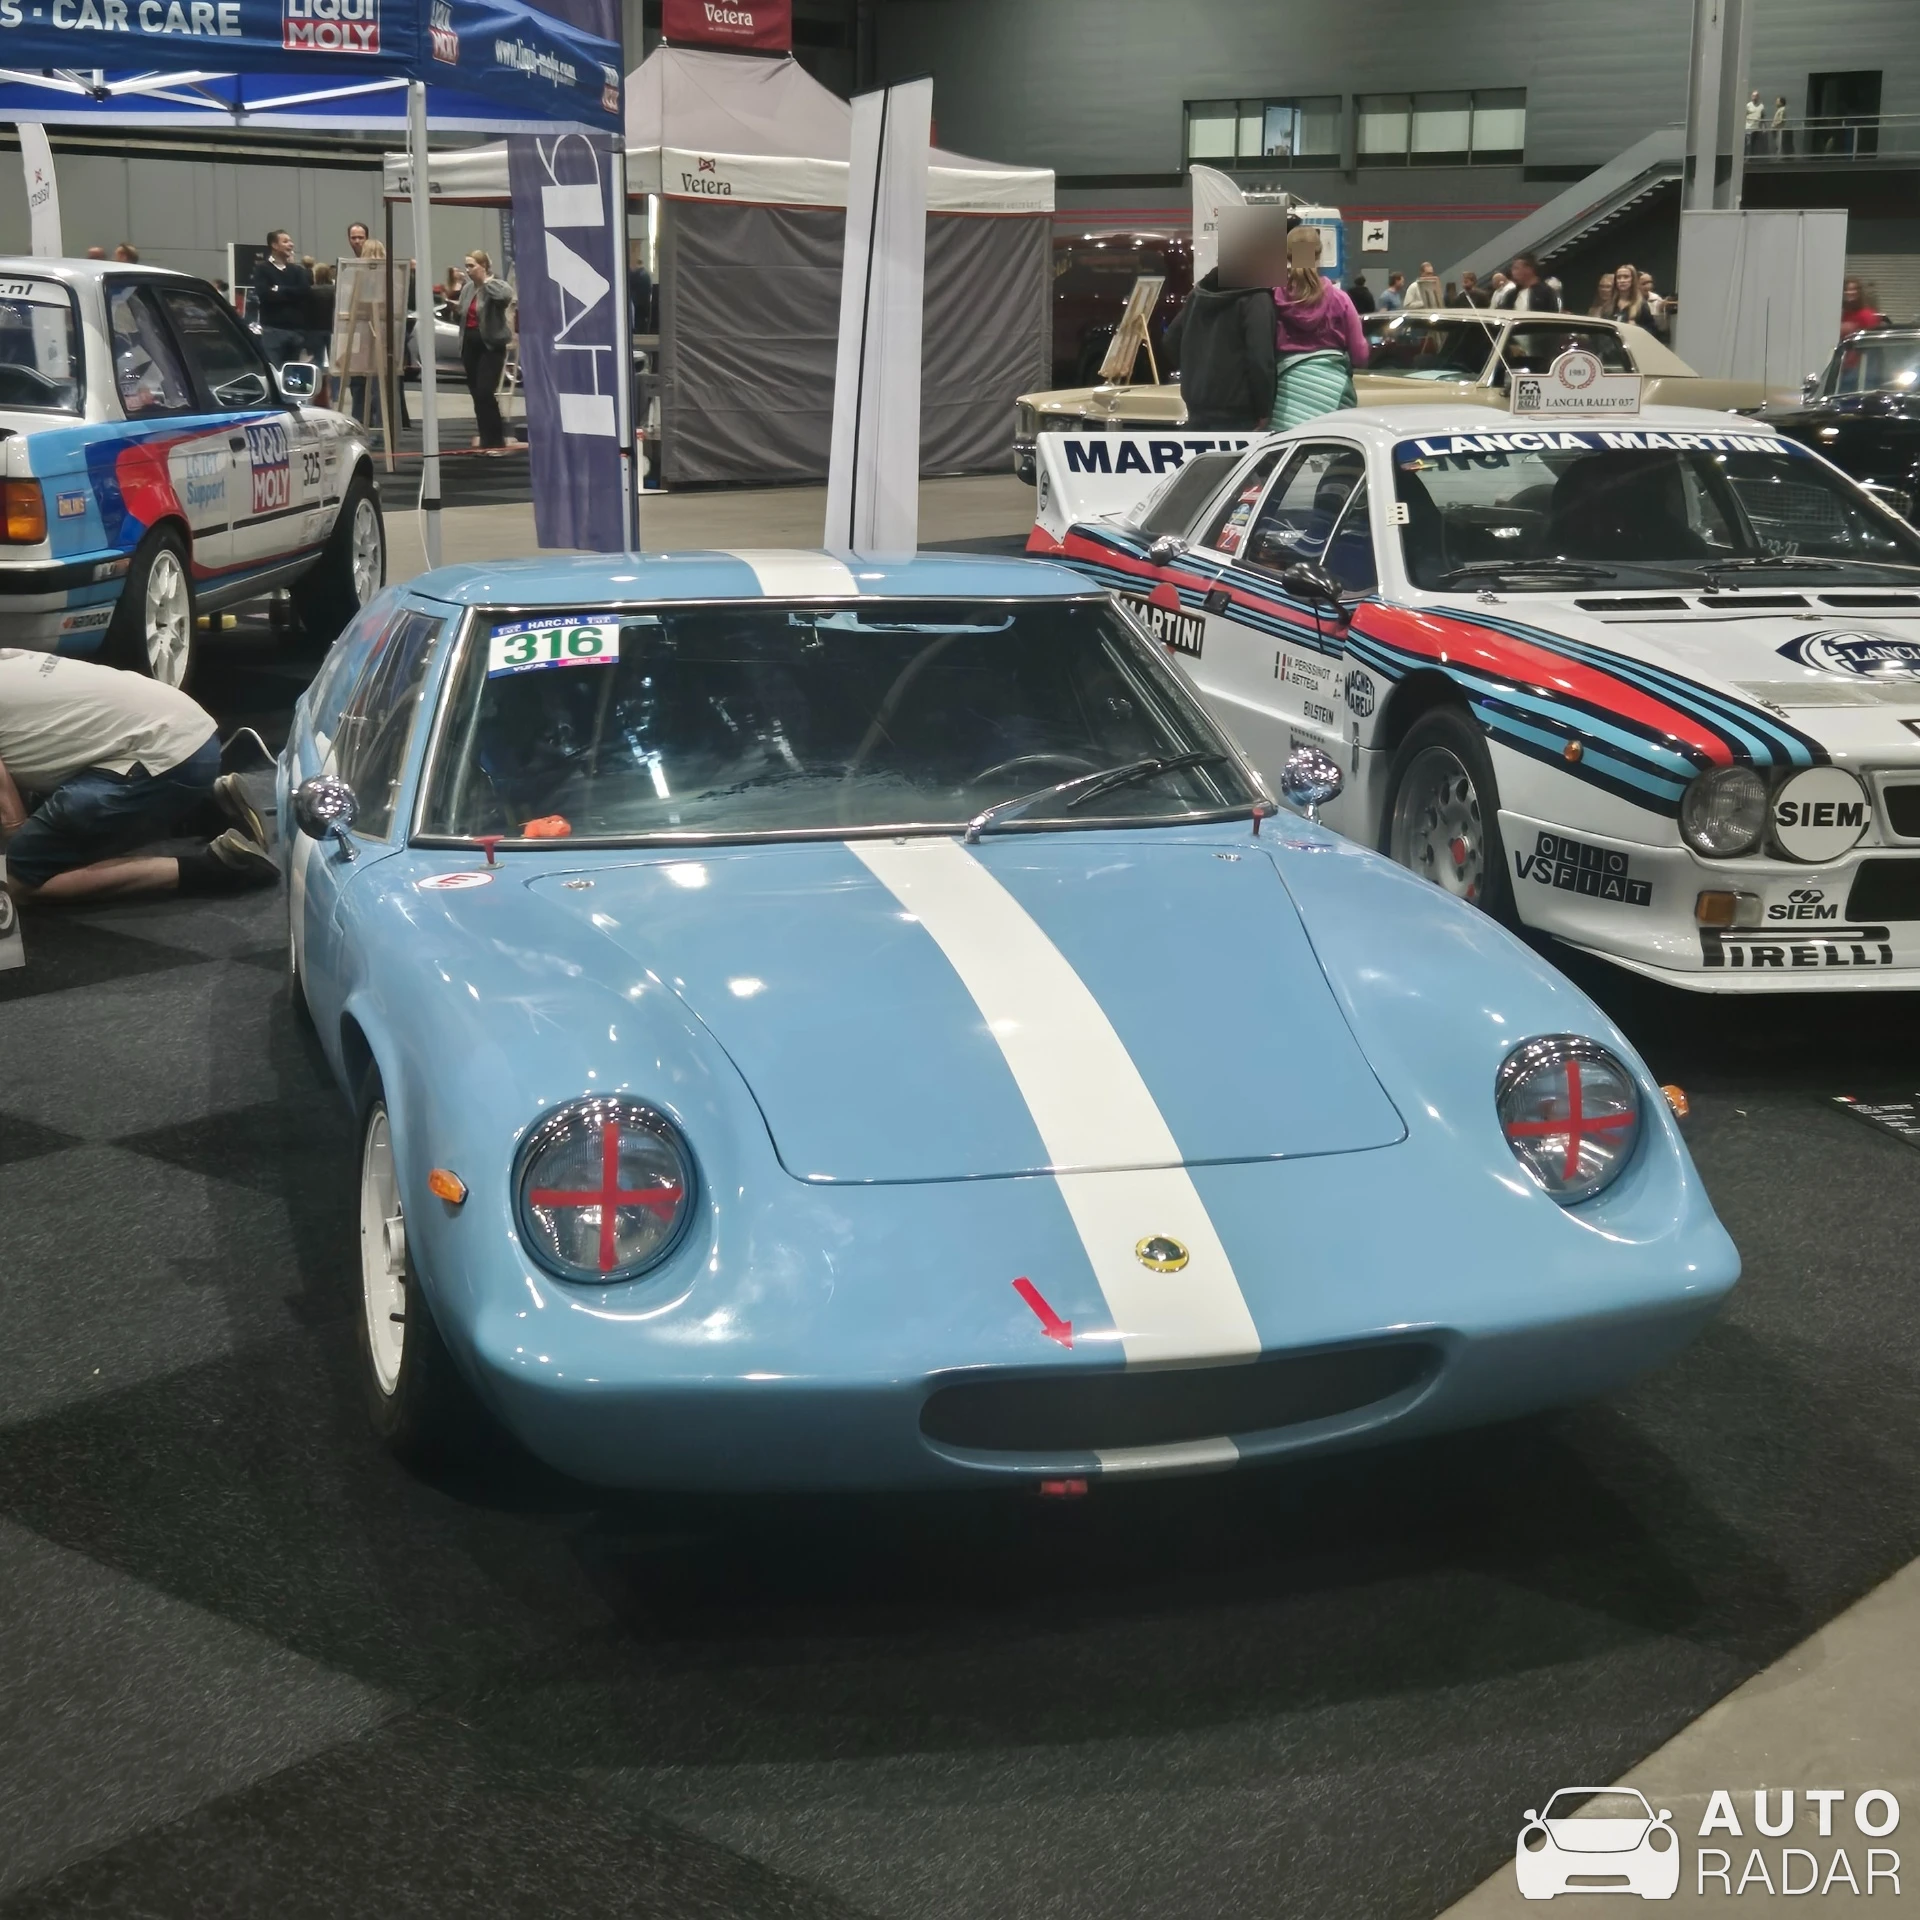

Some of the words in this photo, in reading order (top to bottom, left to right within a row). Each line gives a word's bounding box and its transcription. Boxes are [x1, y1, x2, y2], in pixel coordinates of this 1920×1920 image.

[52, 0, 130, 32] CAR
[138, 2, 242, 37] CARE
[288, 0, 374, 20] LIQUI
[704, 2, 754, 26] Vetera
[288, 22, 376, 50] MOLY
[681, 172, 732, 196] Vetera
[1546, 398, 1584, 407] LANCIA
[1586, 398, 1617, 407] RALLY
[1618, 398, 1635, 407] 037
[248, 426, 288, 465] LIQUI
[1414, 432, 1592, 456] LANCIA
[1599, 431, 1789, 454] MARTINI
[303, 451, 320, 486] 325
[254, 468, 290, 510] MOLY
[528, 617, 581, 630] HARC.NL
[503, 626, 604, 665] 316
[1291, 673, 1319, 691] BETTEGA
[1303, 700, 1335, 726] BILSTEIN
[1776, 801, 1864, 827] SIEM
[1541, 837, 1623, 872] OLIO
[1559, 868, 1646, 901] FIAT
[1767, 904, 1838, 920] SIEM
[1700, 926, 1893, 967] PIRELLI
